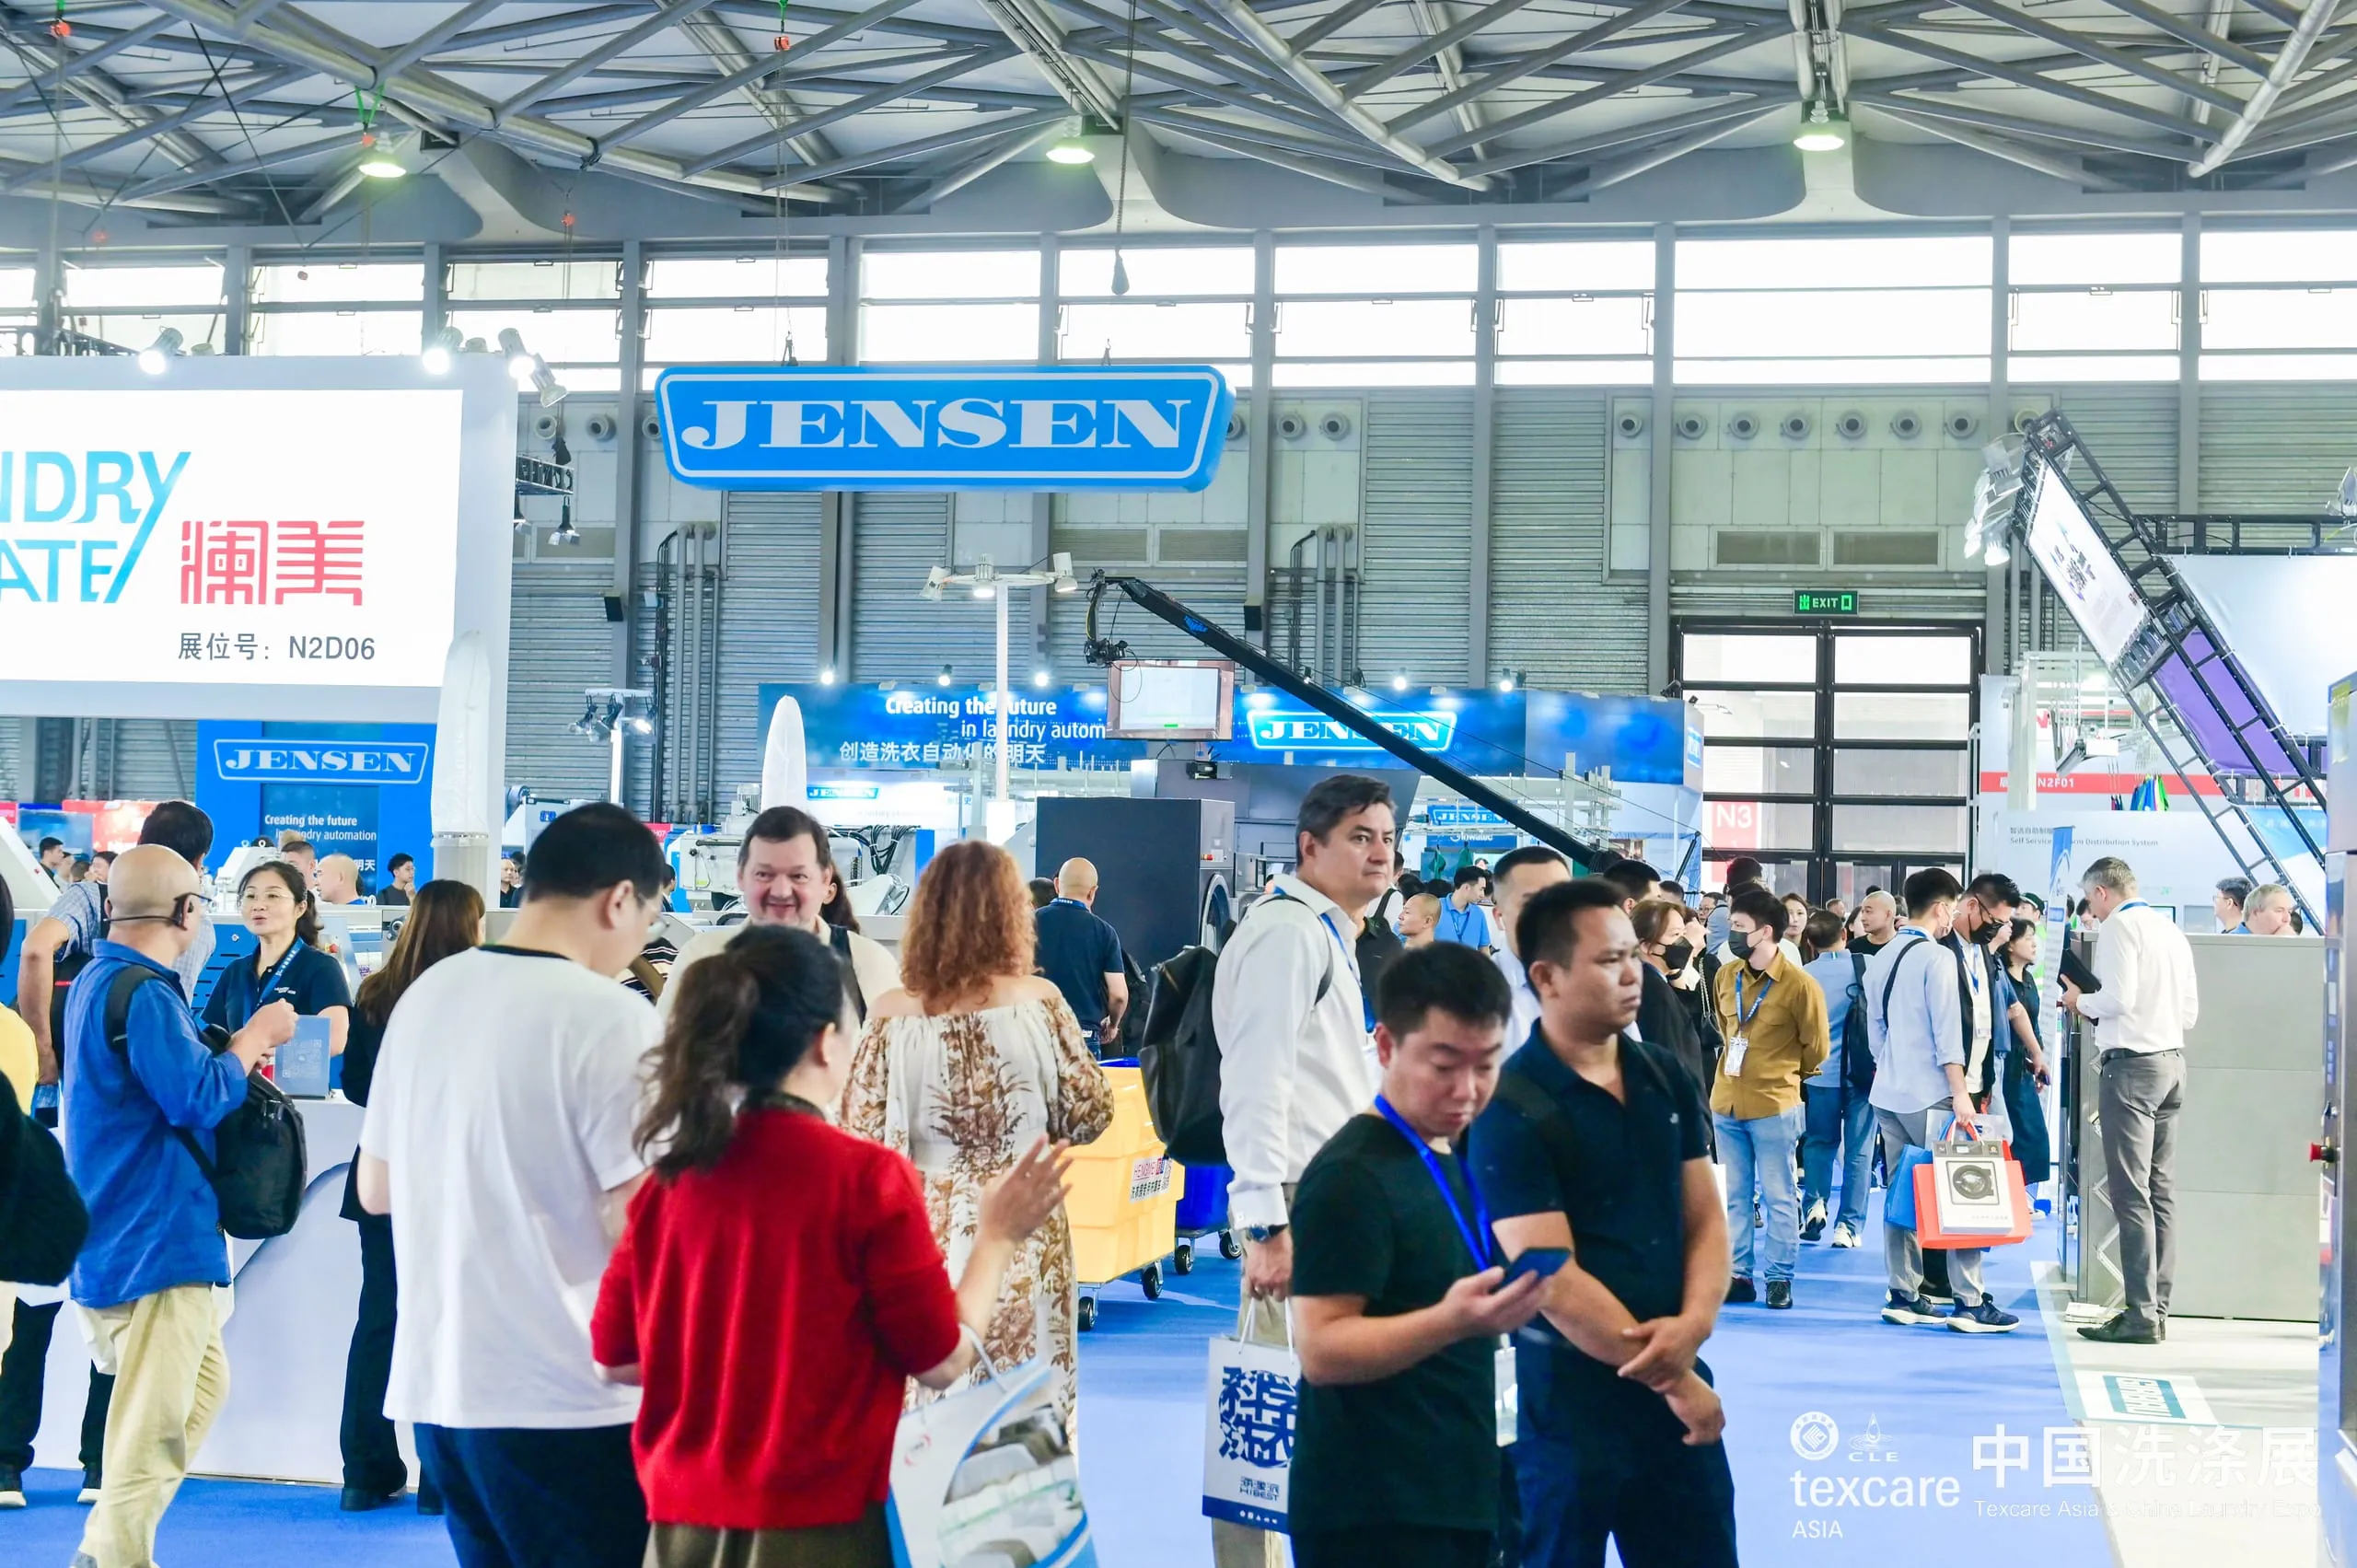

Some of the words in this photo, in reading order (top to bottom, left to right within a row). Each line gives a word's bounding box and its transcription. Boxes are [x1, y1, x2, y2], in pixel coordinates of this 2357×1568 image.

[681, 399, 1191, 449] JENSEN
[1812, 598, 1839, 609] EXIT
[289, 635, 375, 660] N2D06
[885, 696, 960, 719] Creating
[965, 696, 995, 715] the
[1005, 696, 1057, 715] uture
[961, 719, 977, 738] in
[982, 719, 1046, 740] landry
[1051, 721, 1106, 738] autom
[225, 749, 416, 772] JENSEN
[2037, 777, 2074, 788] N2F01
[264, 814, 306, 828] Creating
[308, 814, 324, 825] the
[327, 814, 358, 826] future
[1716, 804, 1753, 828] N3
[323, 830, 377, 841] automation
